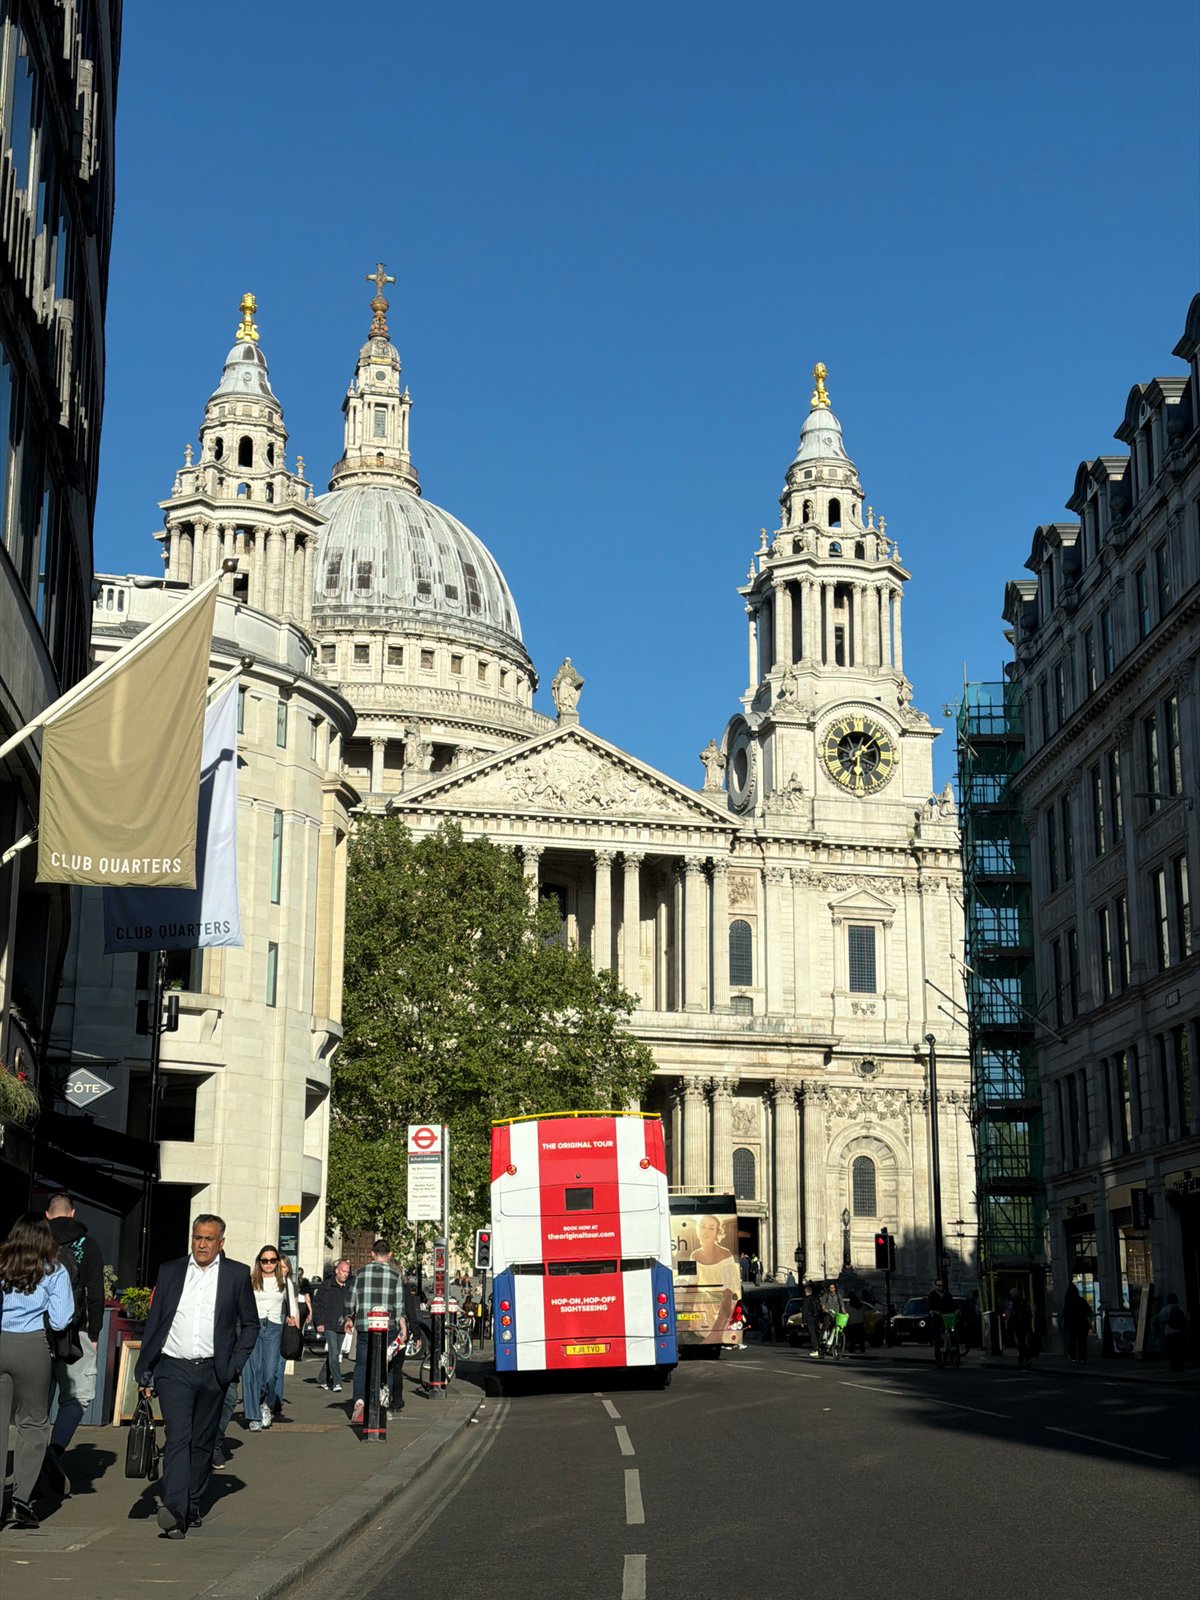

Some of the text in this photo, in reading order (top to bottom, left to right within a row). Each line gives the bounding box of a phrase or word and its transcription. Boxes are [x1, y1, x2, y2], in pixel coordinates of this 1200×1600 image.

[51, 852, 182, 874] CLUB QUARTERS
[116, 920, 231, 940] CLUB QUARTERS
[62, 1079, 101, 1093] CÔTE
[557, 1141, 592, 1149] ORIGINAL
[592, 1140, 613, 1148] TOUR
[547, 1231, 615, 1240] theoriginaltour.com
[560, 1304, 608, 1313] SIGHTSEEING
